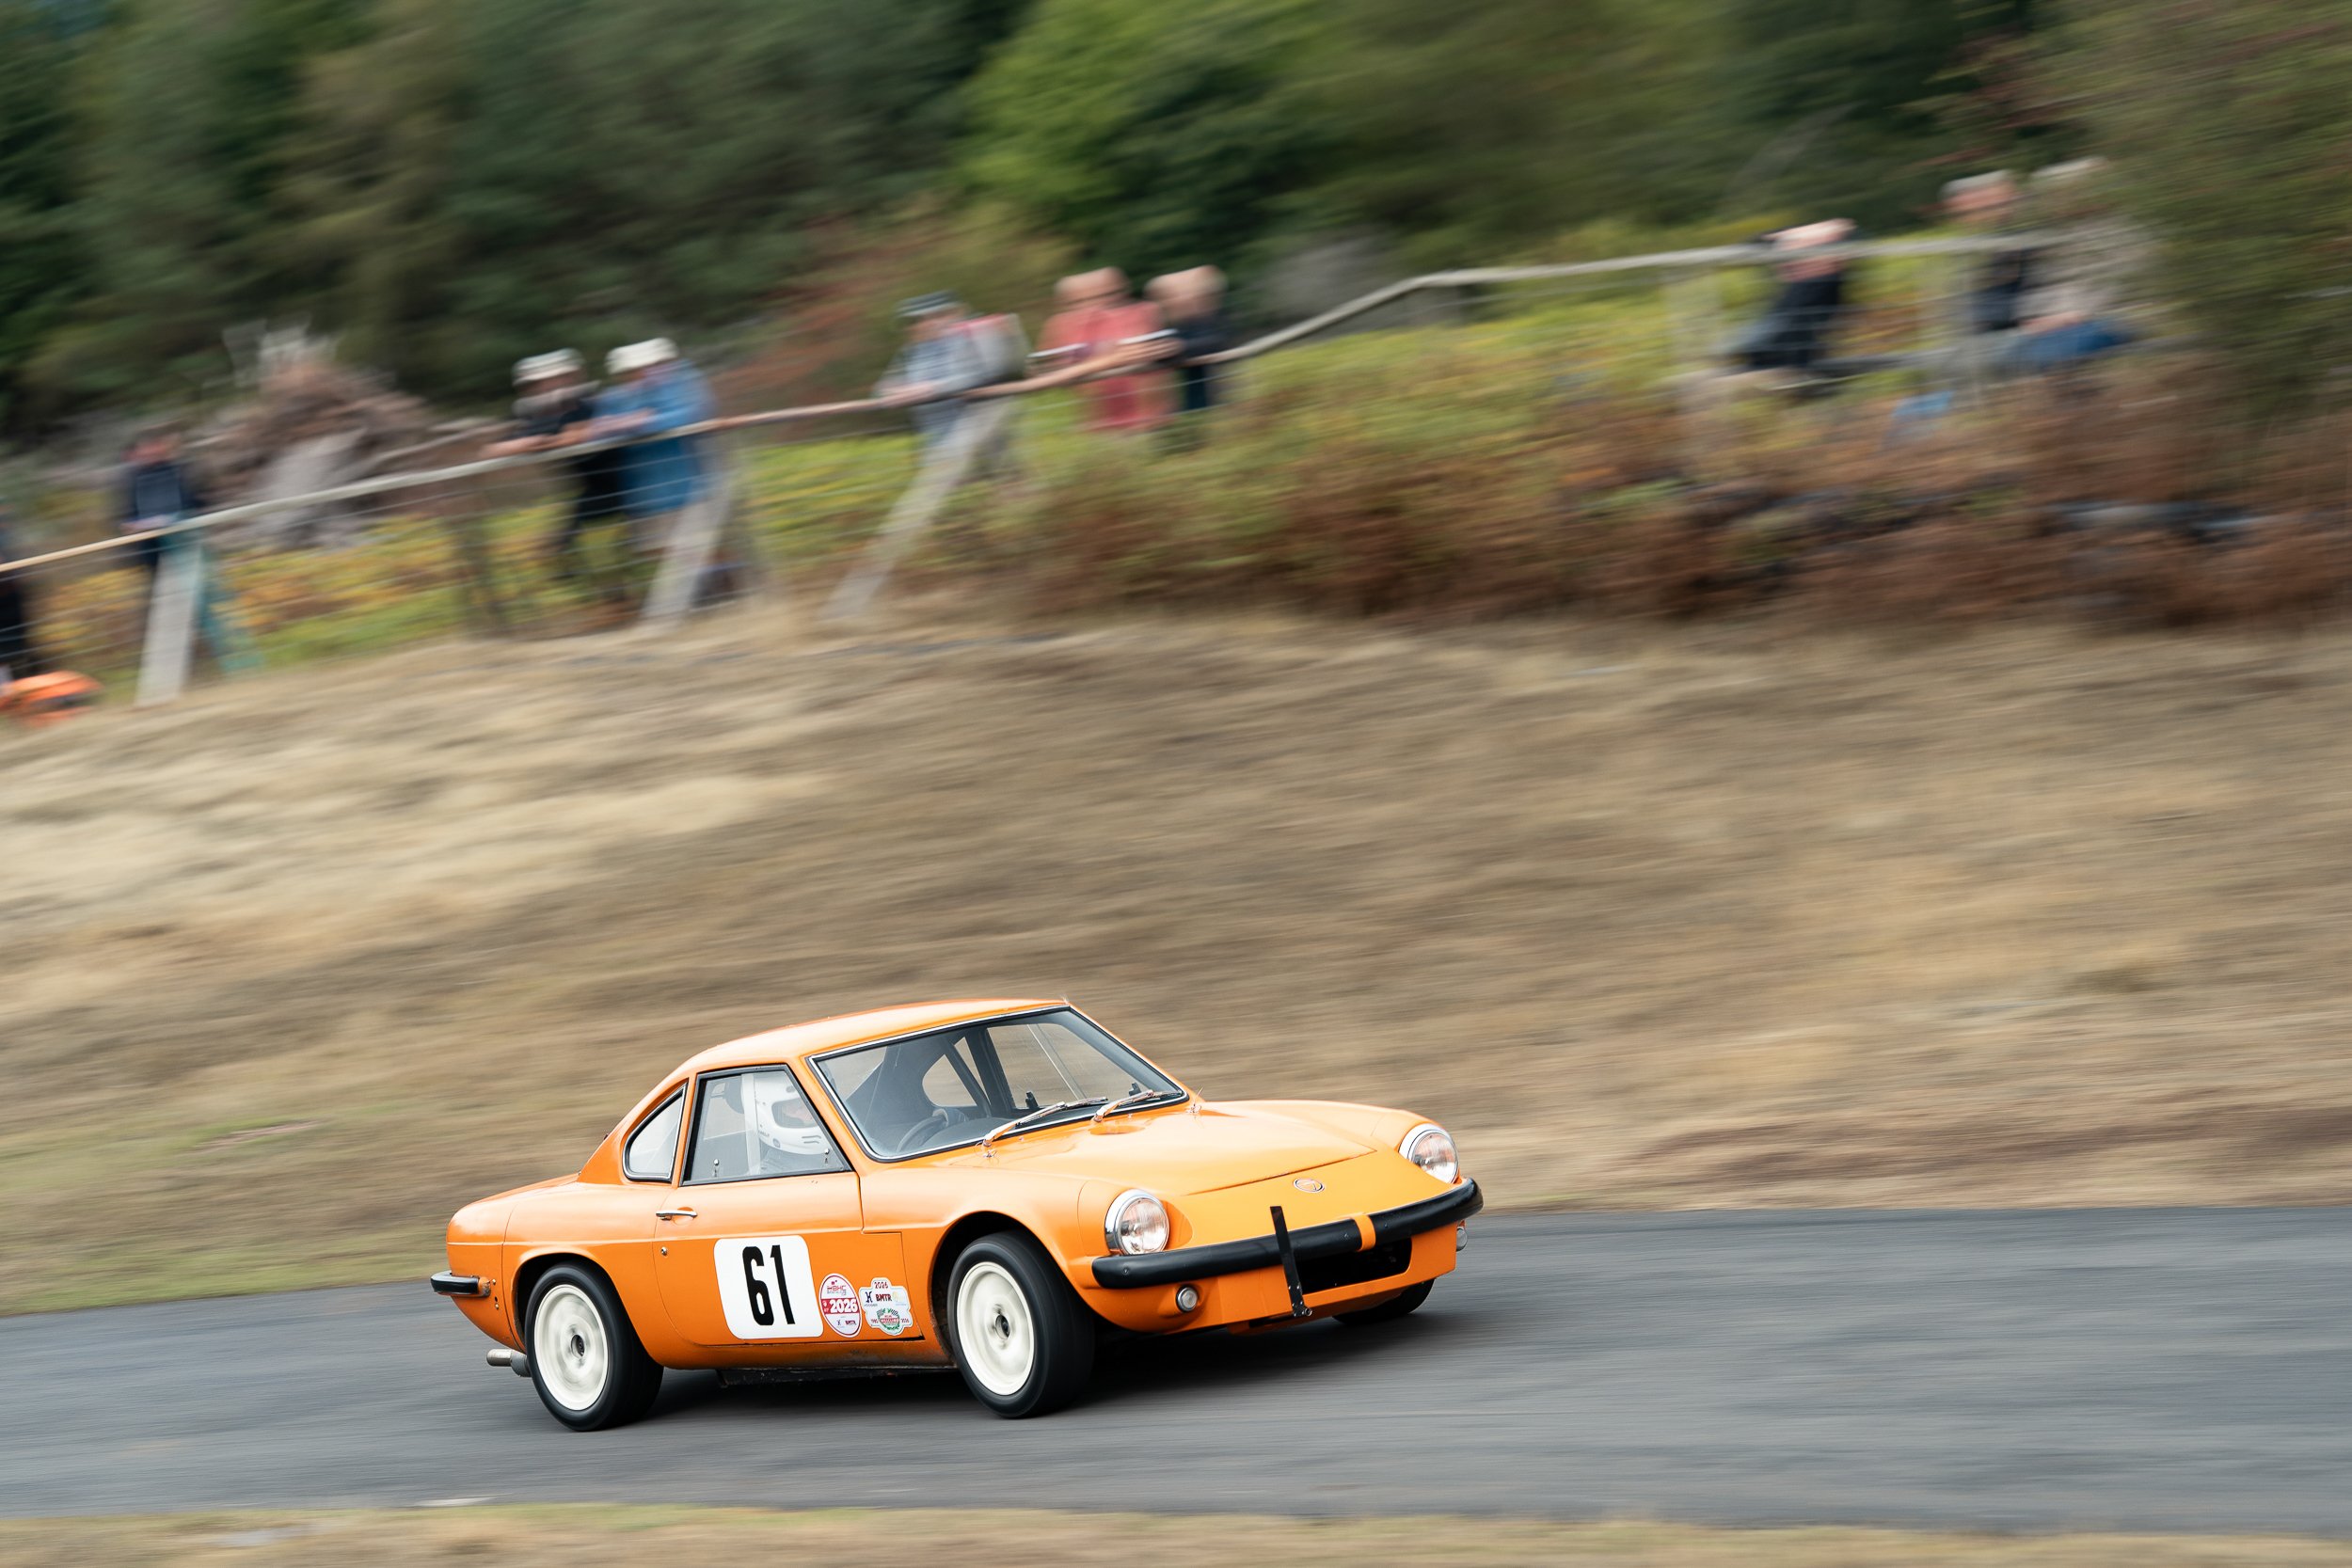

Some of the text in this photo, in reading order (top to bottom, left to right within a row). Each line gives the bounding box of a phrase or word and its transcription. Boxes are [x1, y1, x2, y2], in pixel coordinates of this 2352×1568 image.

[742, 1244, 795, 1325] 61
[875, 1293, 892, 1302] BMTR
[829, 1299, 858, 1313] 2026
